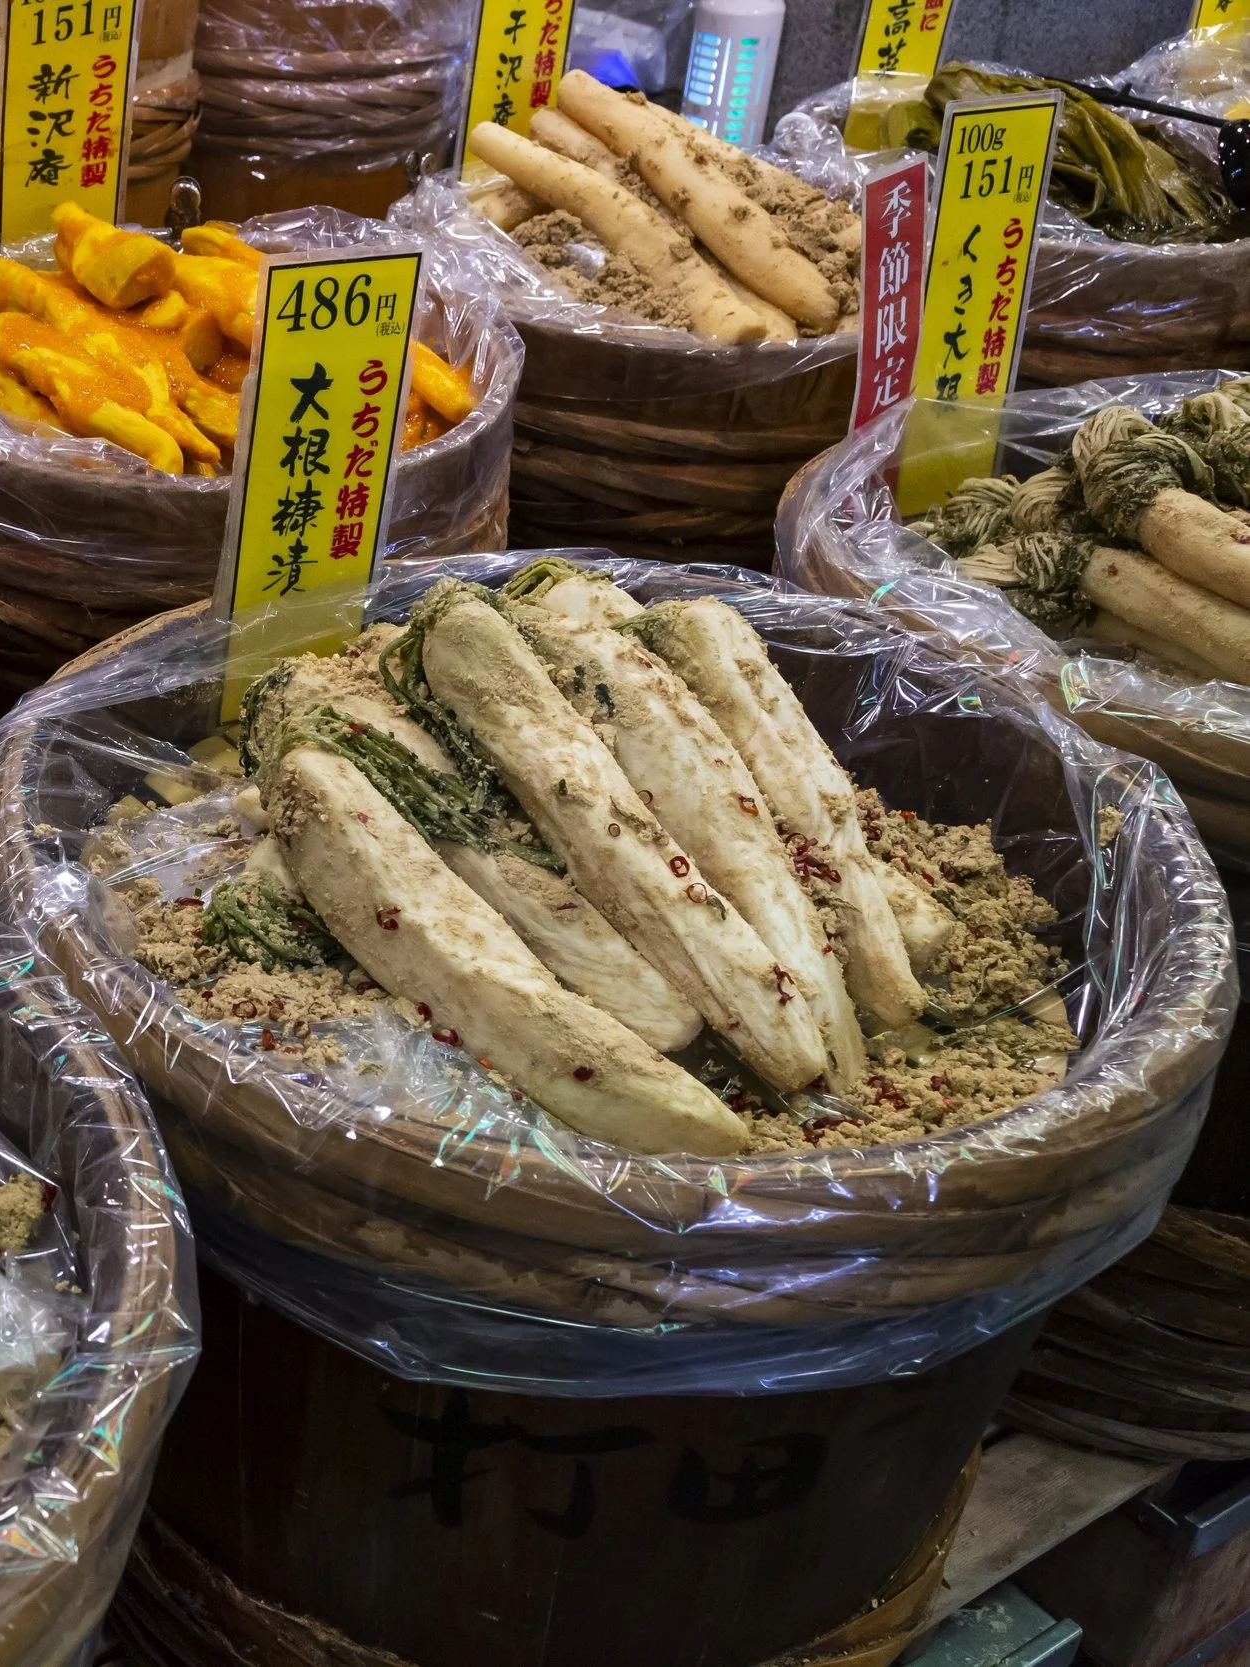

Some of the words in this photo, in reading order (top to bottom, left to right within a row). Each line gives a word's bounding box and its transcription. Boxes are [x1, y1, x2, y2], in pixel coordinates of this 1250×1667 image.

[31, 0, 122, 46] 151円
[25, 63, 80, 188] 新沢庵
[80, 54, 117, 188] うちだ特製
[957, 123, 1007, 155] 100g
[959, 156, 1035, 200] 151円
[276, 273, 397, 335] 486円
[870, 179, 910, 416] 季節限定
[975, 217, 1025, 396] うちだ特製
[329, 358, 389, 561] うちだ特製
